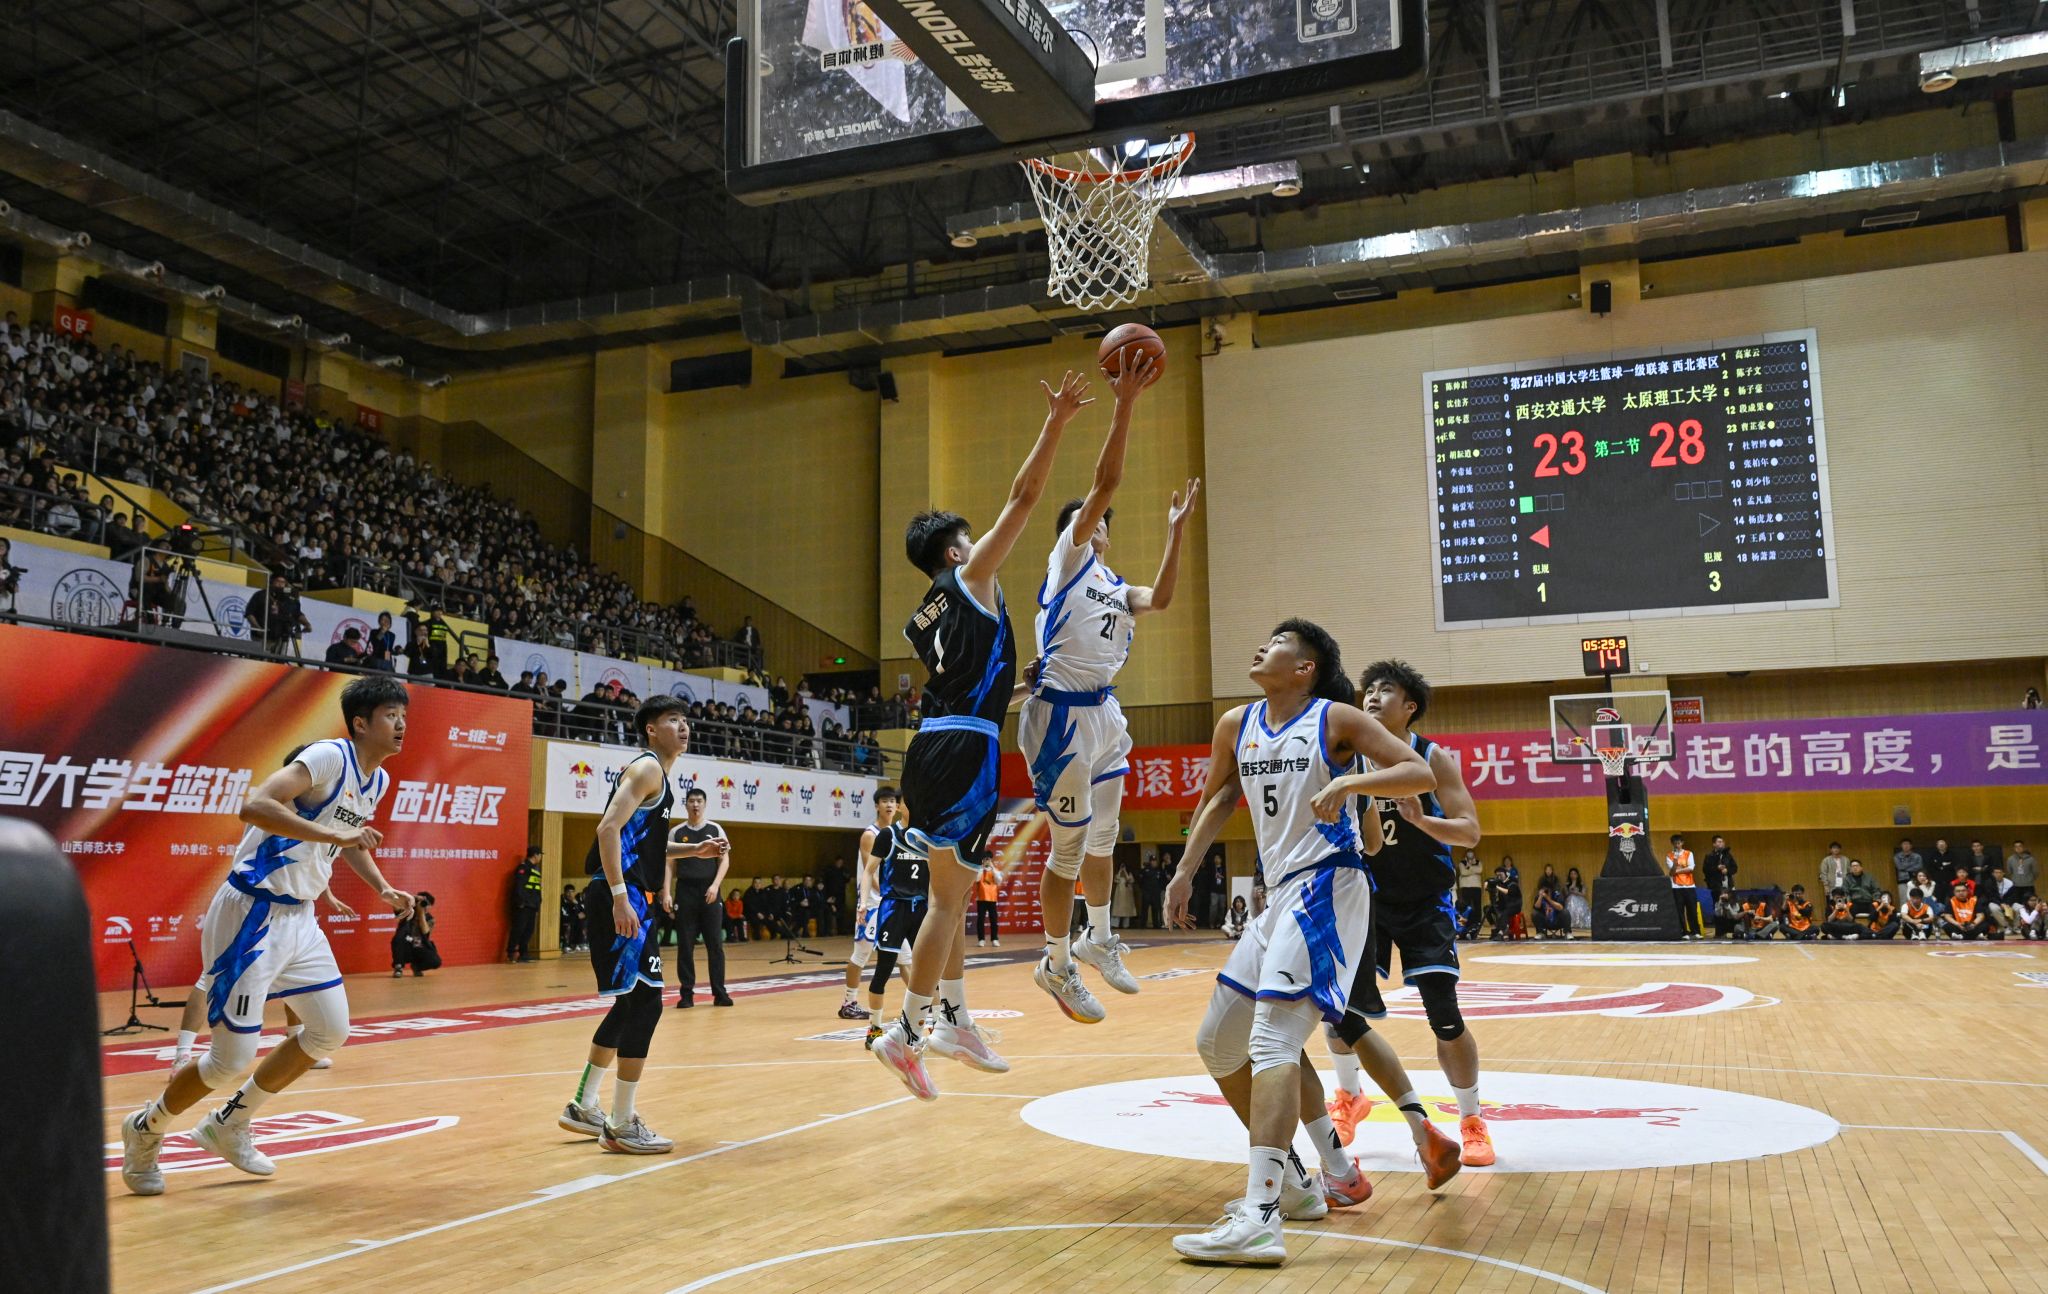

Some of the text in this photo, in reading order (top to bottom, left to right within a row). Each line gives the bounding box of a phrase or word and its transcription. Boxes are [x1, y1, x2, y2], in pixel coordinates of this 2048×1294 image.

[1721, 352, 1726, 361] 1
[1800, 343, 1805, 352] 3
[1510, 355, 1719, 390] 第27届中国大学生篮球一级联赛 西北赛区
[1722, 370, 1728, 379] 2
[1801, 361, 1807, 370] 0
[1433, 384, 1439, 393] 2
[1503, 376, 1508, 385] 3
[1723, 388, 1729, 397] 5
[1802, 380, 1808, 388] 8
[1503, 393, 1509, 402] 0
[1515, 383, 1718, 421] 西安交通大学 太原理工大学
[1725, 405, 1736, 415] 12
[1804, 398, 1810, 407] 0
[1434, 417, 1444, 427] 10
[1504, 410, 1510, 419] 4
[1726, 424, 1737, 434] 23
[1806, 417, 1811, 425] 7
[1436, 435, 1444, 444] 11
[1533, 419, 1706, 477] 23 第二节 28
[1728, 442, 1733, 451] 7
[1808, 435, 1813, 444] 5
[1436, 454, 1446, 463] 21
[1506, 445, 1512, 454] 0
[1729, 461, 1735, 470] 8
[1809, 454, 1815, 463] 0
[1437, 470, 1442, 478] 1
[1507, 463, 1513, 471] 0
[1438, 487, 1443, 496] 3
[1509, 480, 1514, 489] 3
[1731, 479, 1741, 488] 10
[1811, 473, 1816, 481] 0
[1509, 498, 1515, 507] 0
[1732, 498, 1742, 507] 11
[1812, 491, 1818, 500] 0
[1510, 516, 1516, 524] 0
[1734, 516, 1744, 525] 14
[1814, 510, 1819, 519] 1
[1441, 539, 1451, 548] 13
[1511, 534, 1517, 542] 0
[1735, 534, 1746, 544] 17
[1816, 529, 1821, 538] 4
[1513, 552, 1518, 560] 2
[1737, 553, 1747, 563] 18
[1817, 548, 1823, 557] 0
[1514, 569, 1519, 578] 5
[1708, 570, 1722, 592] 3
[1537, 582, 1546, 602] 1
[914, 592, 949, 631] 高家云
[1100, 612, 1117, 641] 21
[1583, 639, 1627, 651] 05:29.9
[1600, 648, 1621, 669] 14
[604, 766, 619, 783] tc
[1241, 758, 1310, 777] 西安交通大学
[678, 773, 694, 791] tcp
[743, 779, 757, 799] tcp
[390, 780, 506, 826] 西北赛区
[800, 785, 813, 804] tcp
[851, 791, 863, 808] tcp
[1263, 784, 1279, 817] 5
[1059, 797, 1076, 814] 21
[61, 841, 125, 855] 山西师范大学
[911, 864, 920, 880] 2
[882, 931, 889, 942] 2
[236, 995, 250, 1016] 11
